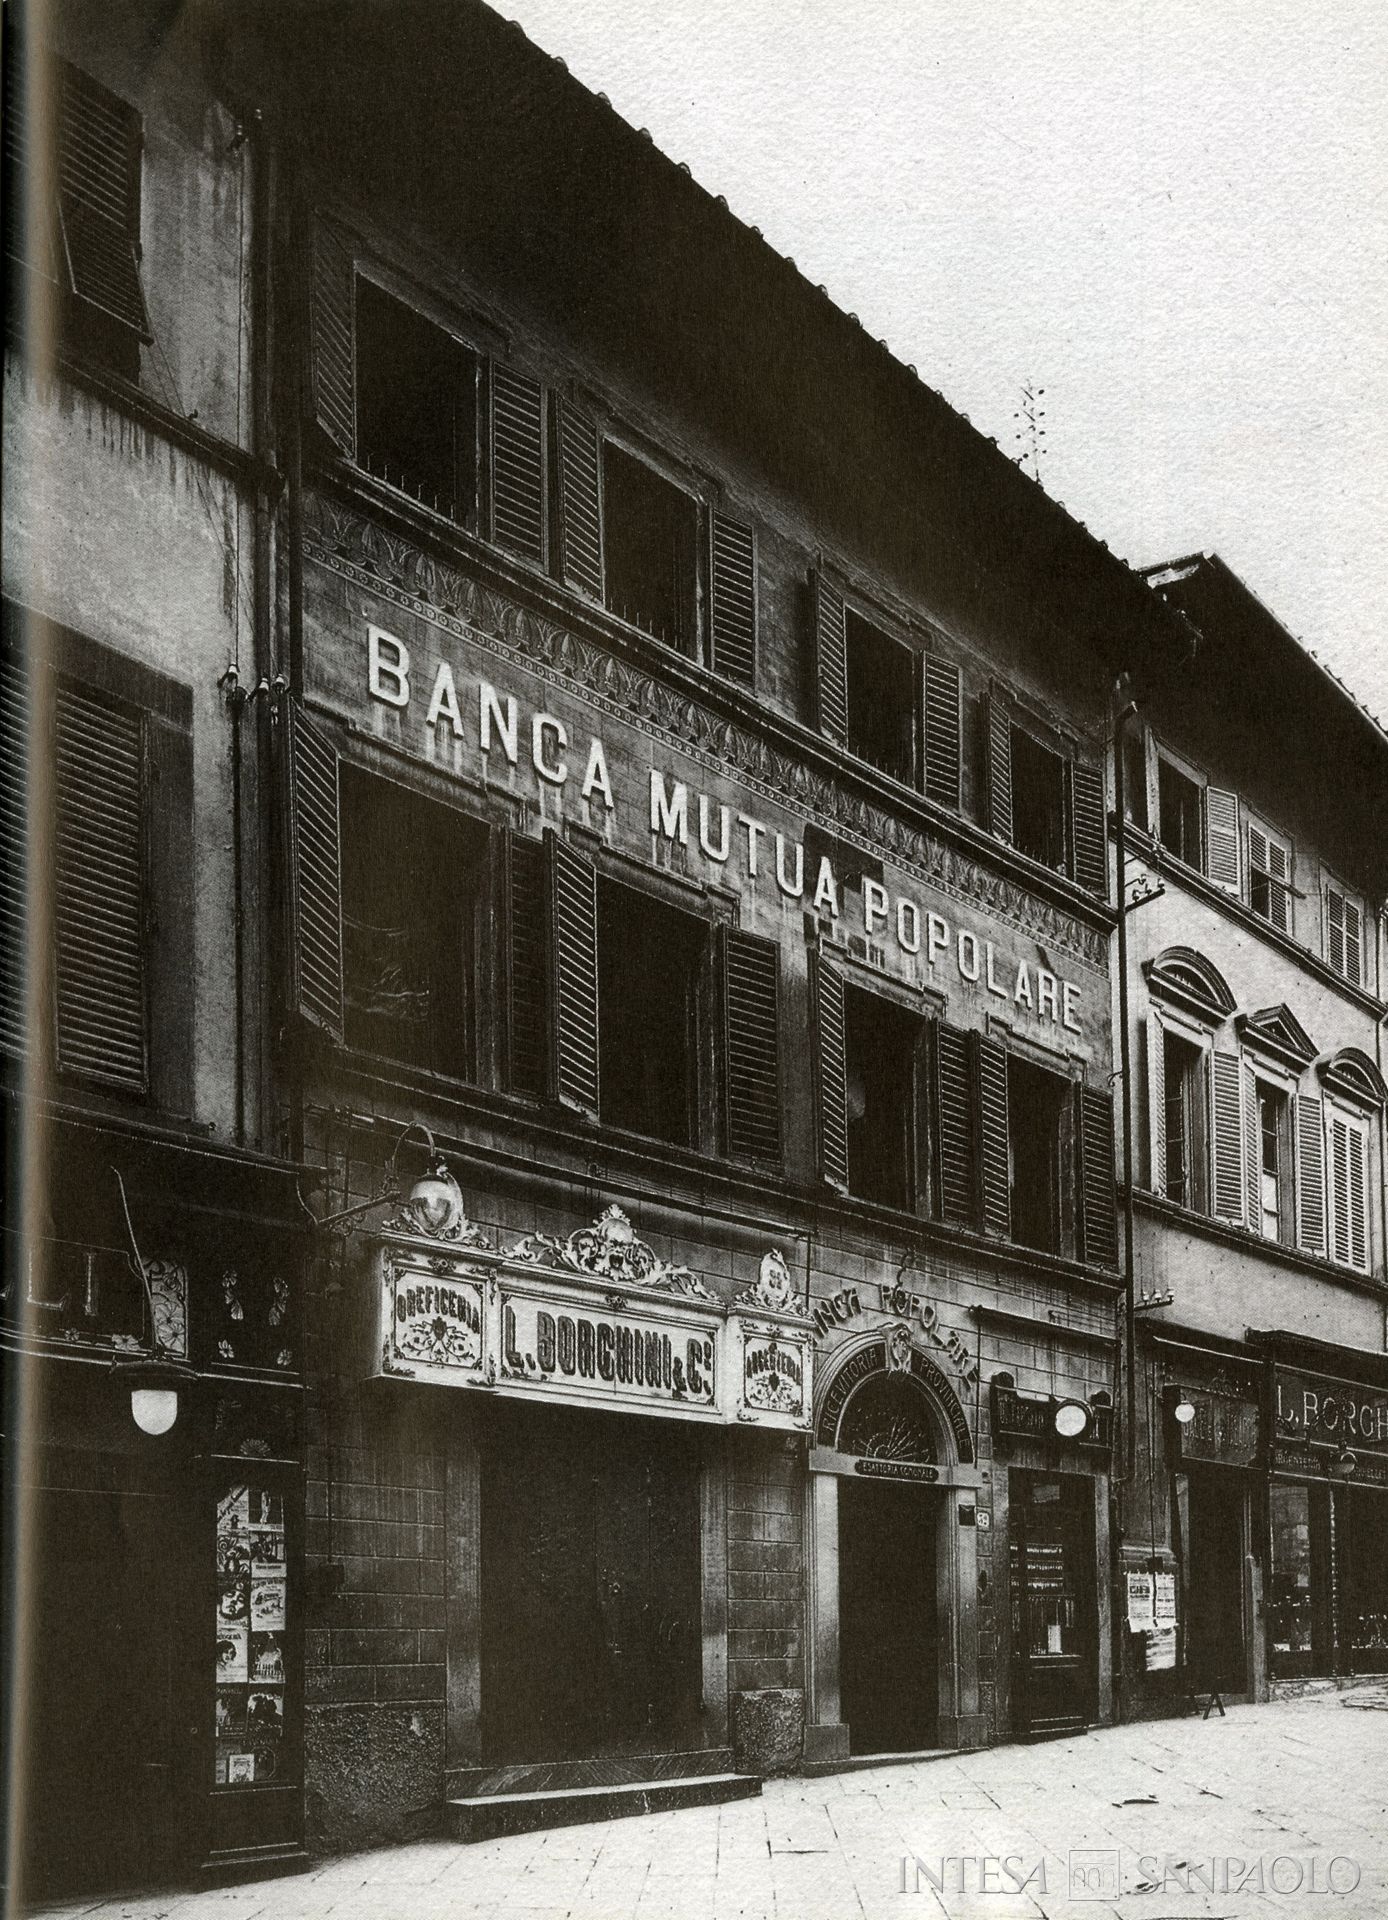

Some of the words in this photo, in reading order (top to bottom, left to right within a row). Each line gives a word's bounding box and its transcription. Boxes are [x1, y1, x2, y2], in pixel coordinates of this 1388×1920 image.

[366, 625, 615, 808] BANCA
[650, 768, 839, 917] MUTUA
[862, 877, 1082, 1034] POPOLARE
[397, 1285, 480, 1334] OREFICERIA
[505, 1305, 535, 1370] L.
[537, 1310, 672, 1389] BORGHINI
[822, 1348, 878, 1431] RICEVITORIA
[920, 1357, 970, 1448] PROVINCIALE
